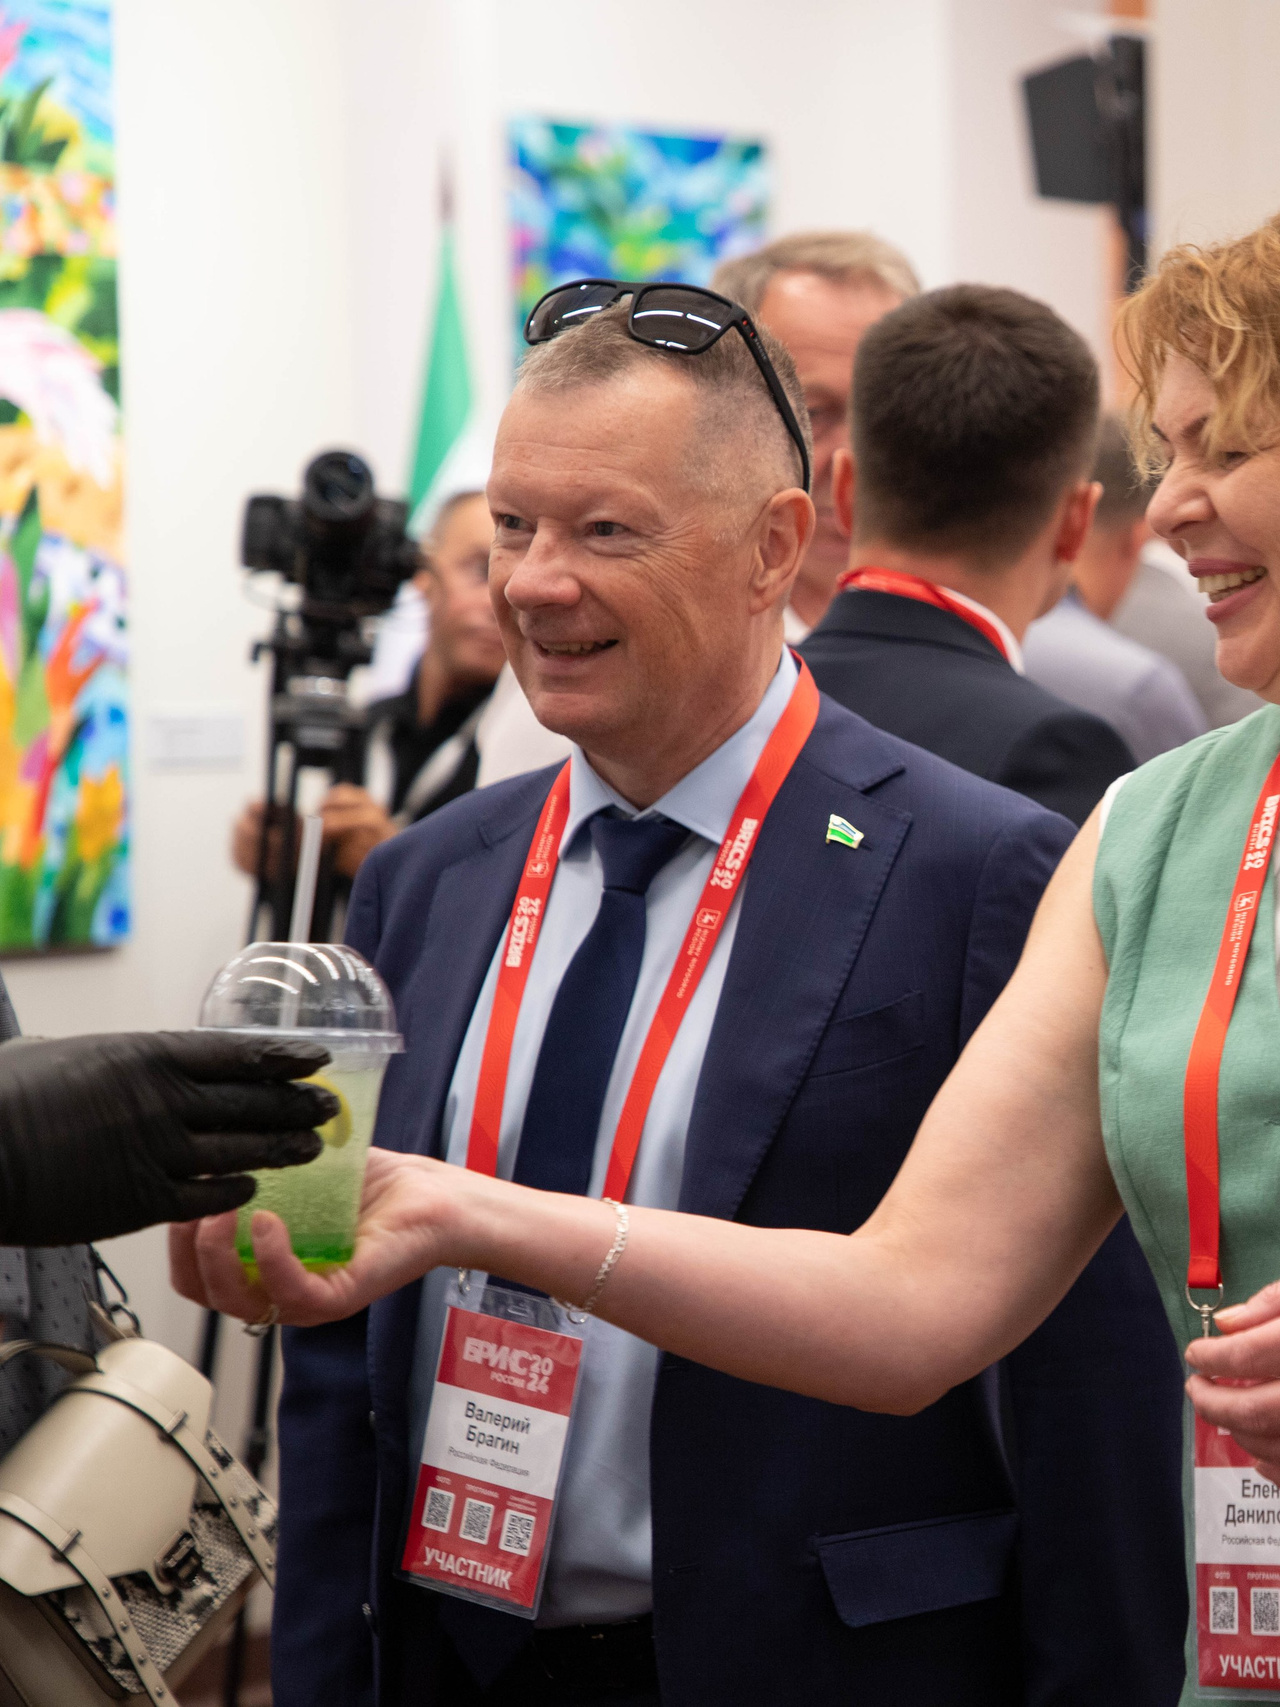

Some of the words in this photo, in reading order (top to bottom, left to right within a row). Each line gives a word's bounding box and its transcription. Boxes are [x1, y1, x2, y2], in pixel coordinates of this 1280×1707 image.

[1255, 794, 1280, 850] BRICS
[725, 817, 759, 870] BRICS
[710, 866, 726, 887] 24
[720, 869, 738, 890] 20
[517, 896, 531, 917] 20
[528, 897, 542, 917] 24
[505, 915, 530, 968] BRICS
[530, 1354, 554, 1376] 20
[526, 1371, 550, 1395] 24
[465, 1400, 531, 1434] Валерий
[466, 1424, 520, 1455] Брагин
[1221, 1534, 1265, 1546] Российская
[423, 1546, 513, 1591] УЧАСТНИК
